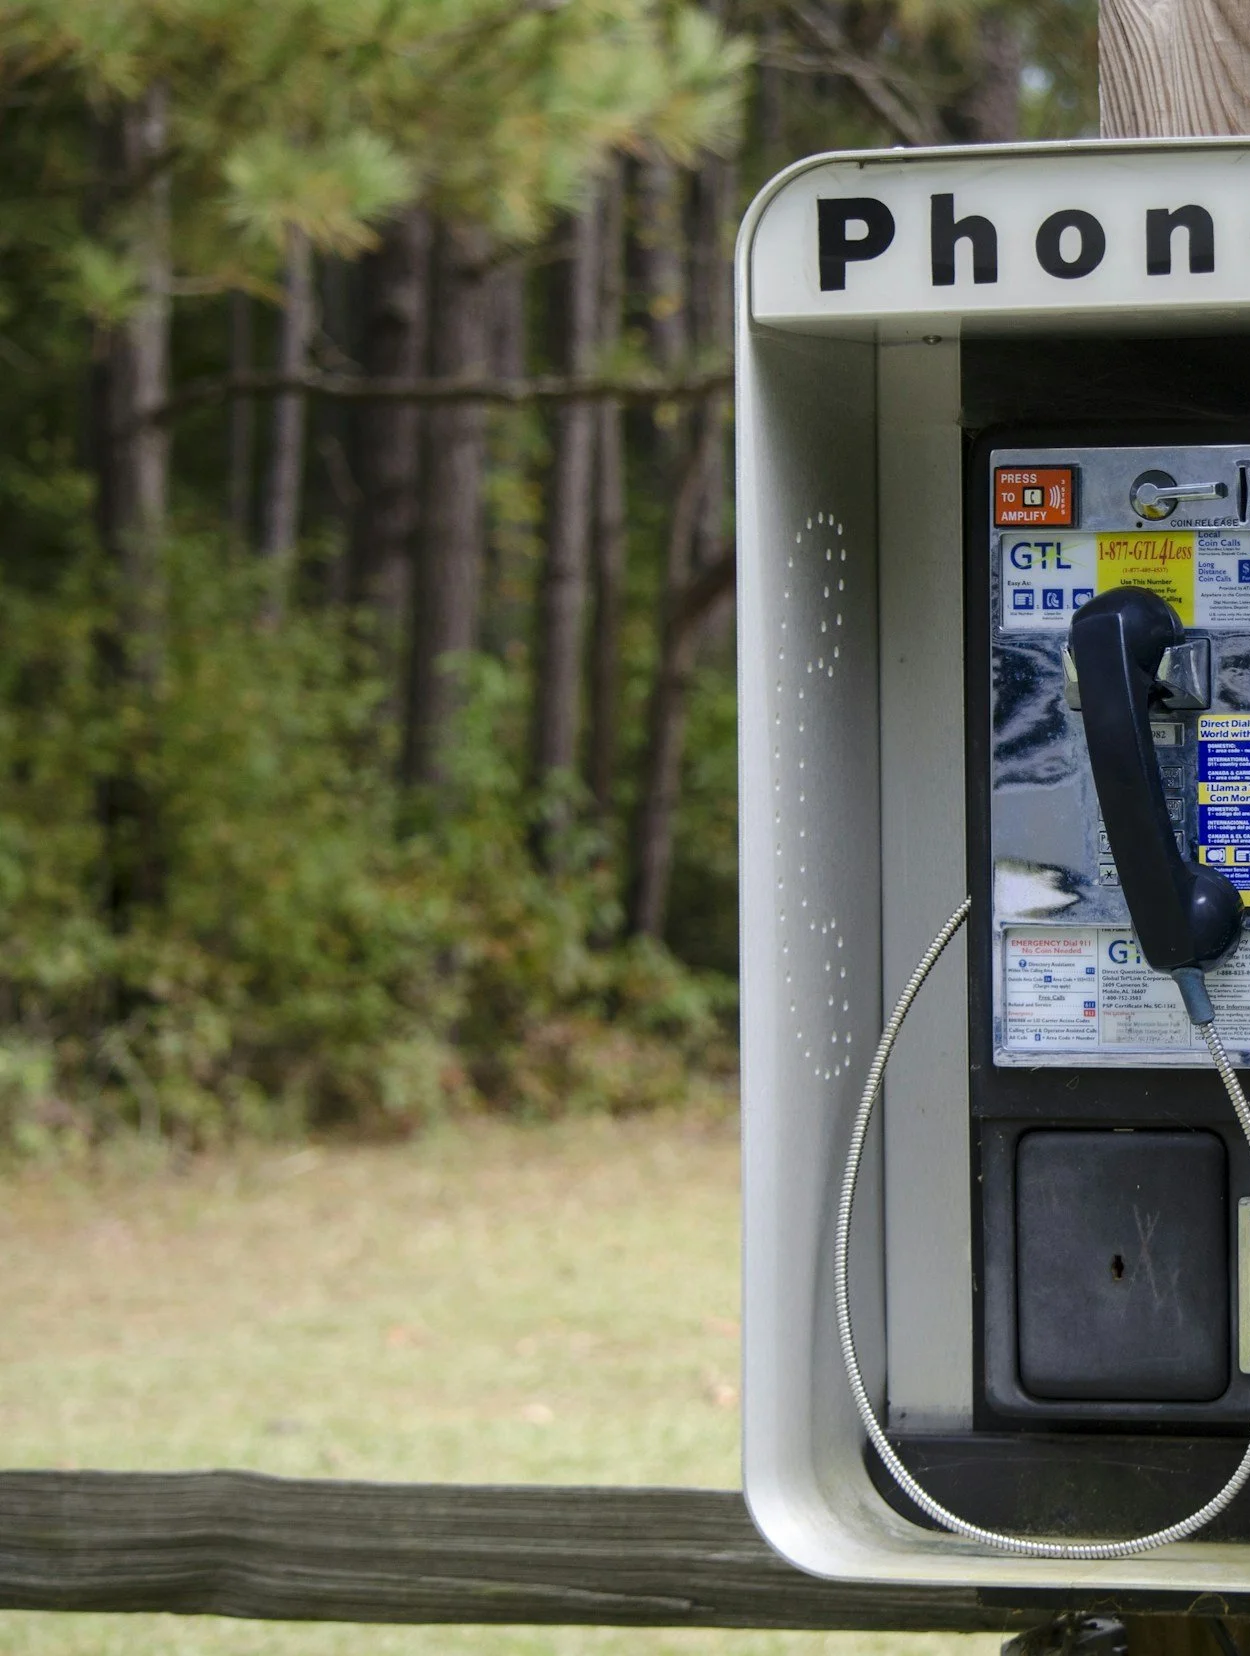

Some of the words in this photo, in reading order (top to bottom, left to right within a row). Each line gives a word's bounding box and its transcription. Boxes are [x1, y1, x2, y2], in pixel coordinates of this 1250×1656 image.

[1001, 474, 1037, 484] PRESS
[1001, 492, 1016, 503] TO
[1001, 511, 1047, 521] AMPLIFY
[1170, 520, 1192, 528] COIN
[1195, 518, 1239, 527] RELEASE
[1198, 539, 1218, 547] Coin
[1220, 539, 1240, 547] Calls
[1010, 542, 1071, 570] GTL
[1099, 538, 1192, 565] 1-877-GTL4Less
[1200, 730, 1228, 738] World
[1209, 794, 1228, 802] Con
